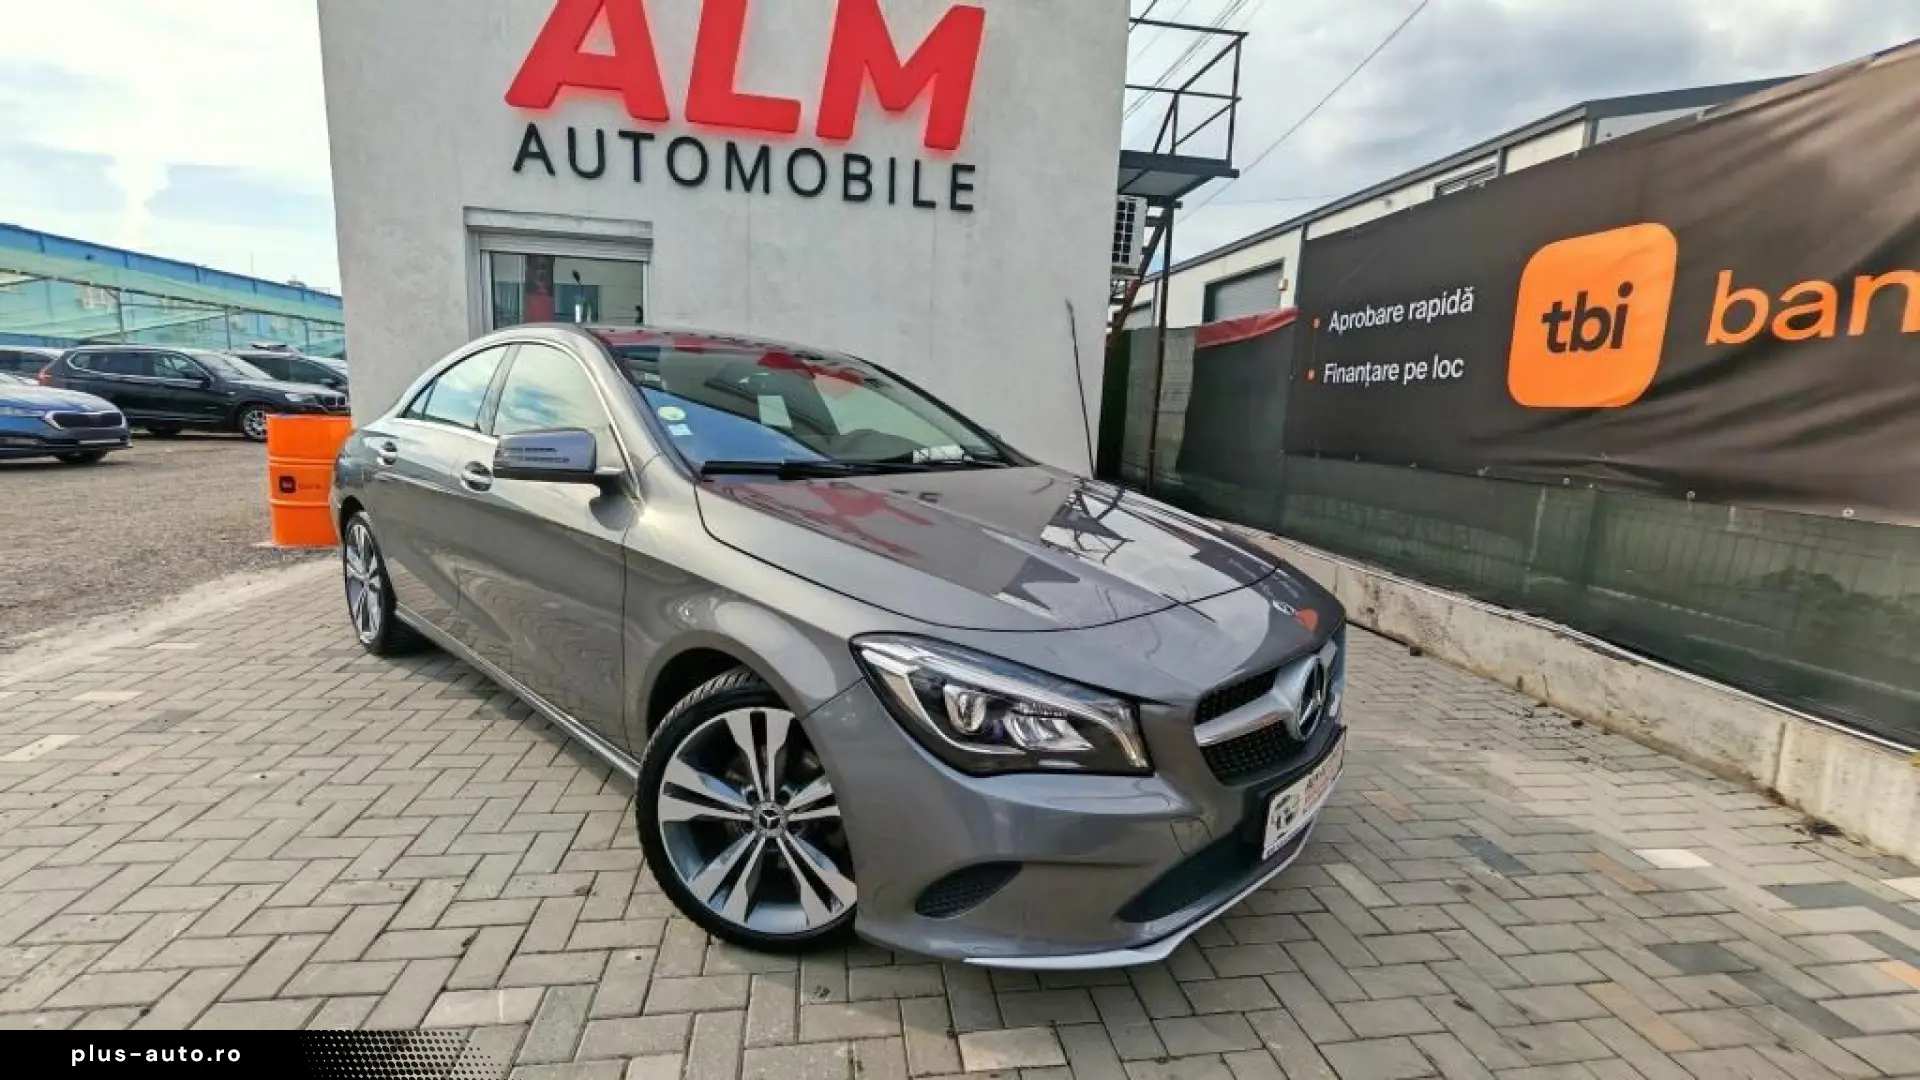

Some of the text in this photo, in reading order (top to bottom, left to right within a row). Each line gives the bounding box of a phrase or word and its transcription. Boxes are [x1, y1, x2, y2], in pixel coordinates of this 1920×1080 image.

[504, 0, 986, 151] ALM
[512, 122, 976, 212] AUTOMOBILE
[1328, 286, 1475, 336] Aprobare rapidă
[1541, 281, 1634, 354] tbi
[1402, 361, 1428, 385] pe
[1432, 353, 1465, 380] loc
